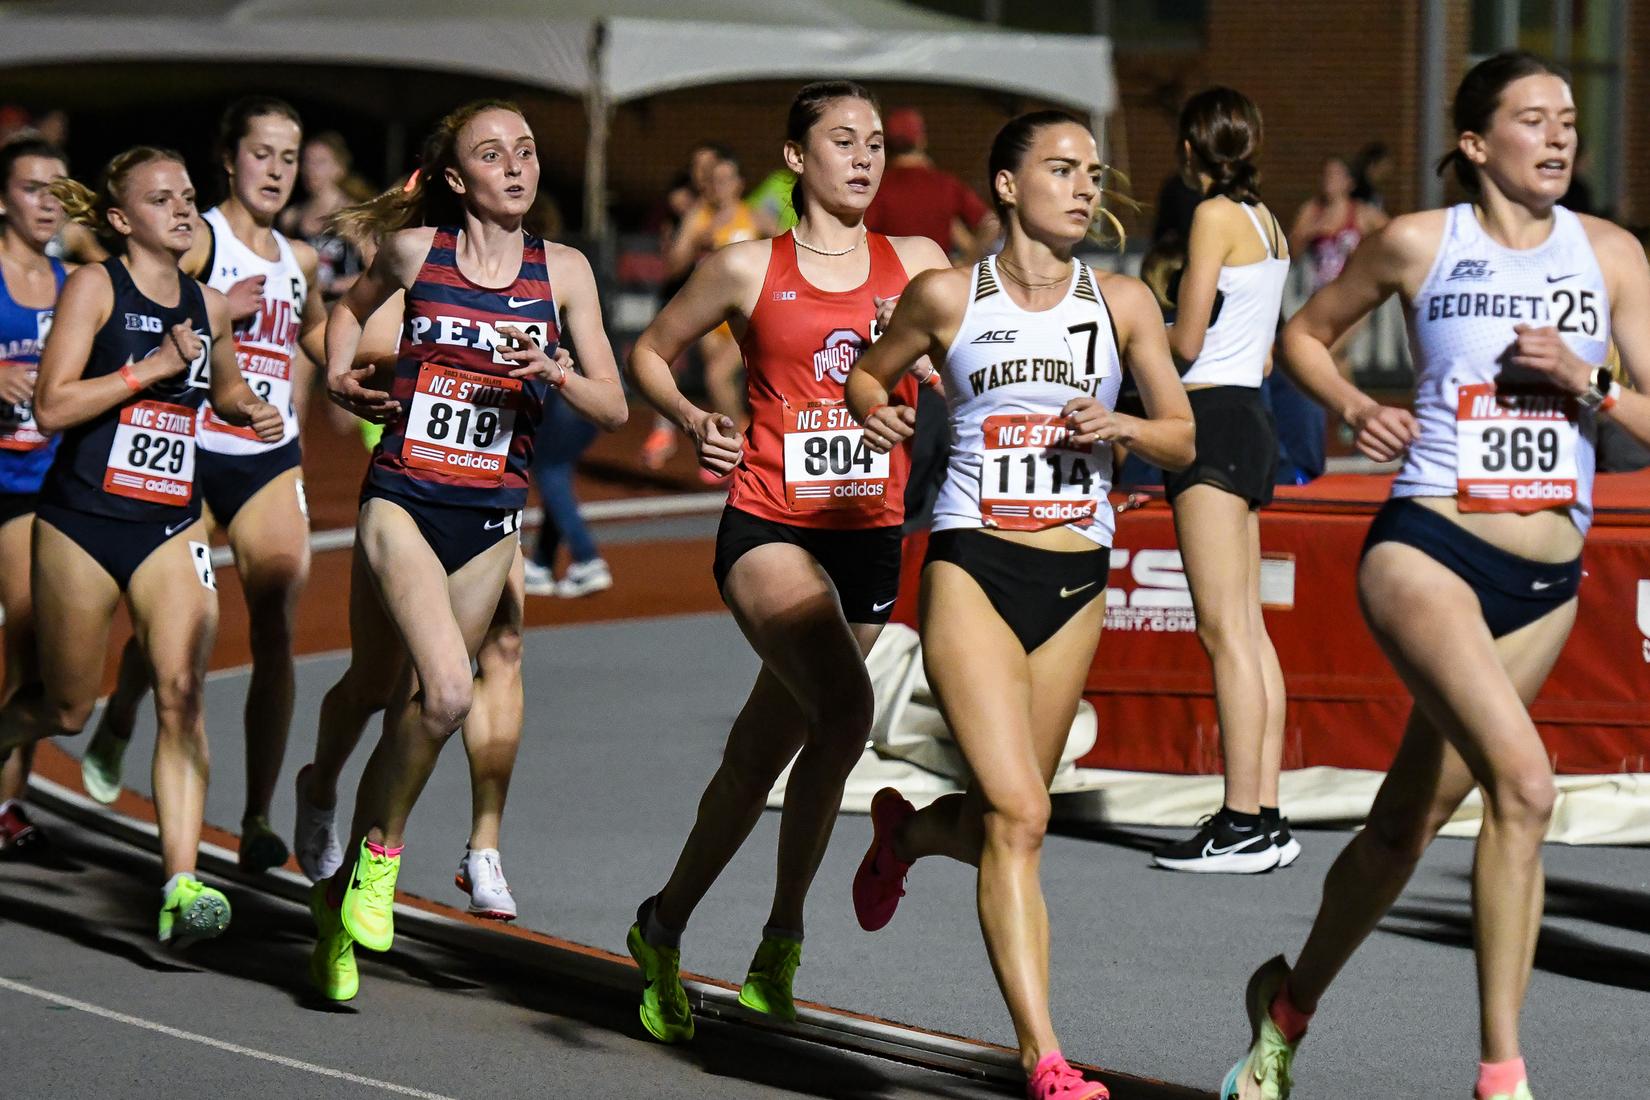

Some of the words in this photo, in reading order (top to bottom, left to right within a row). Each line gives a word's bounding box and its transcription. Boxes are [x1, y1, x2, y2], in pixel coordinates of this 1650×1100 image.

[1428, 293, 1550, 321] GEORGET
[1551, 289, 1598, 336] 25
[411, 315, 497, 351] PEN
[974, 330, 1019, 341] ACC
[1067, 321, 1098, 375] 7
[249, 356, 287, 377] STATE
[968, 359, 1028, 397] WAKE
[428, 375, 456, 397] NC
[457, 382, 511, 406] STATE
[131, 407, 156, 427] NC
[156, 412, 191, 434] STATE
[427, 403, 498, 448] 819
[797, 410, 823, 430] NC
[827, 408, 859, 428] STA
[998, 426, 1026, 446] NC
[1030, 425, 1075, 446] STA
[1482, 427, 1558, 472] 369
[128, 433, 185, 474] 829
[447, 453, 500, 471] adidas
[804, 435, 873, 476] 804
[145, 479, 189, 496] adidas
[993, 454, 1094, 494] 1114
[834, 482, 883, 497] adidas
[1511, 481, 1573, 499] adidas
[1033, 503, 1091, 519] adidas
